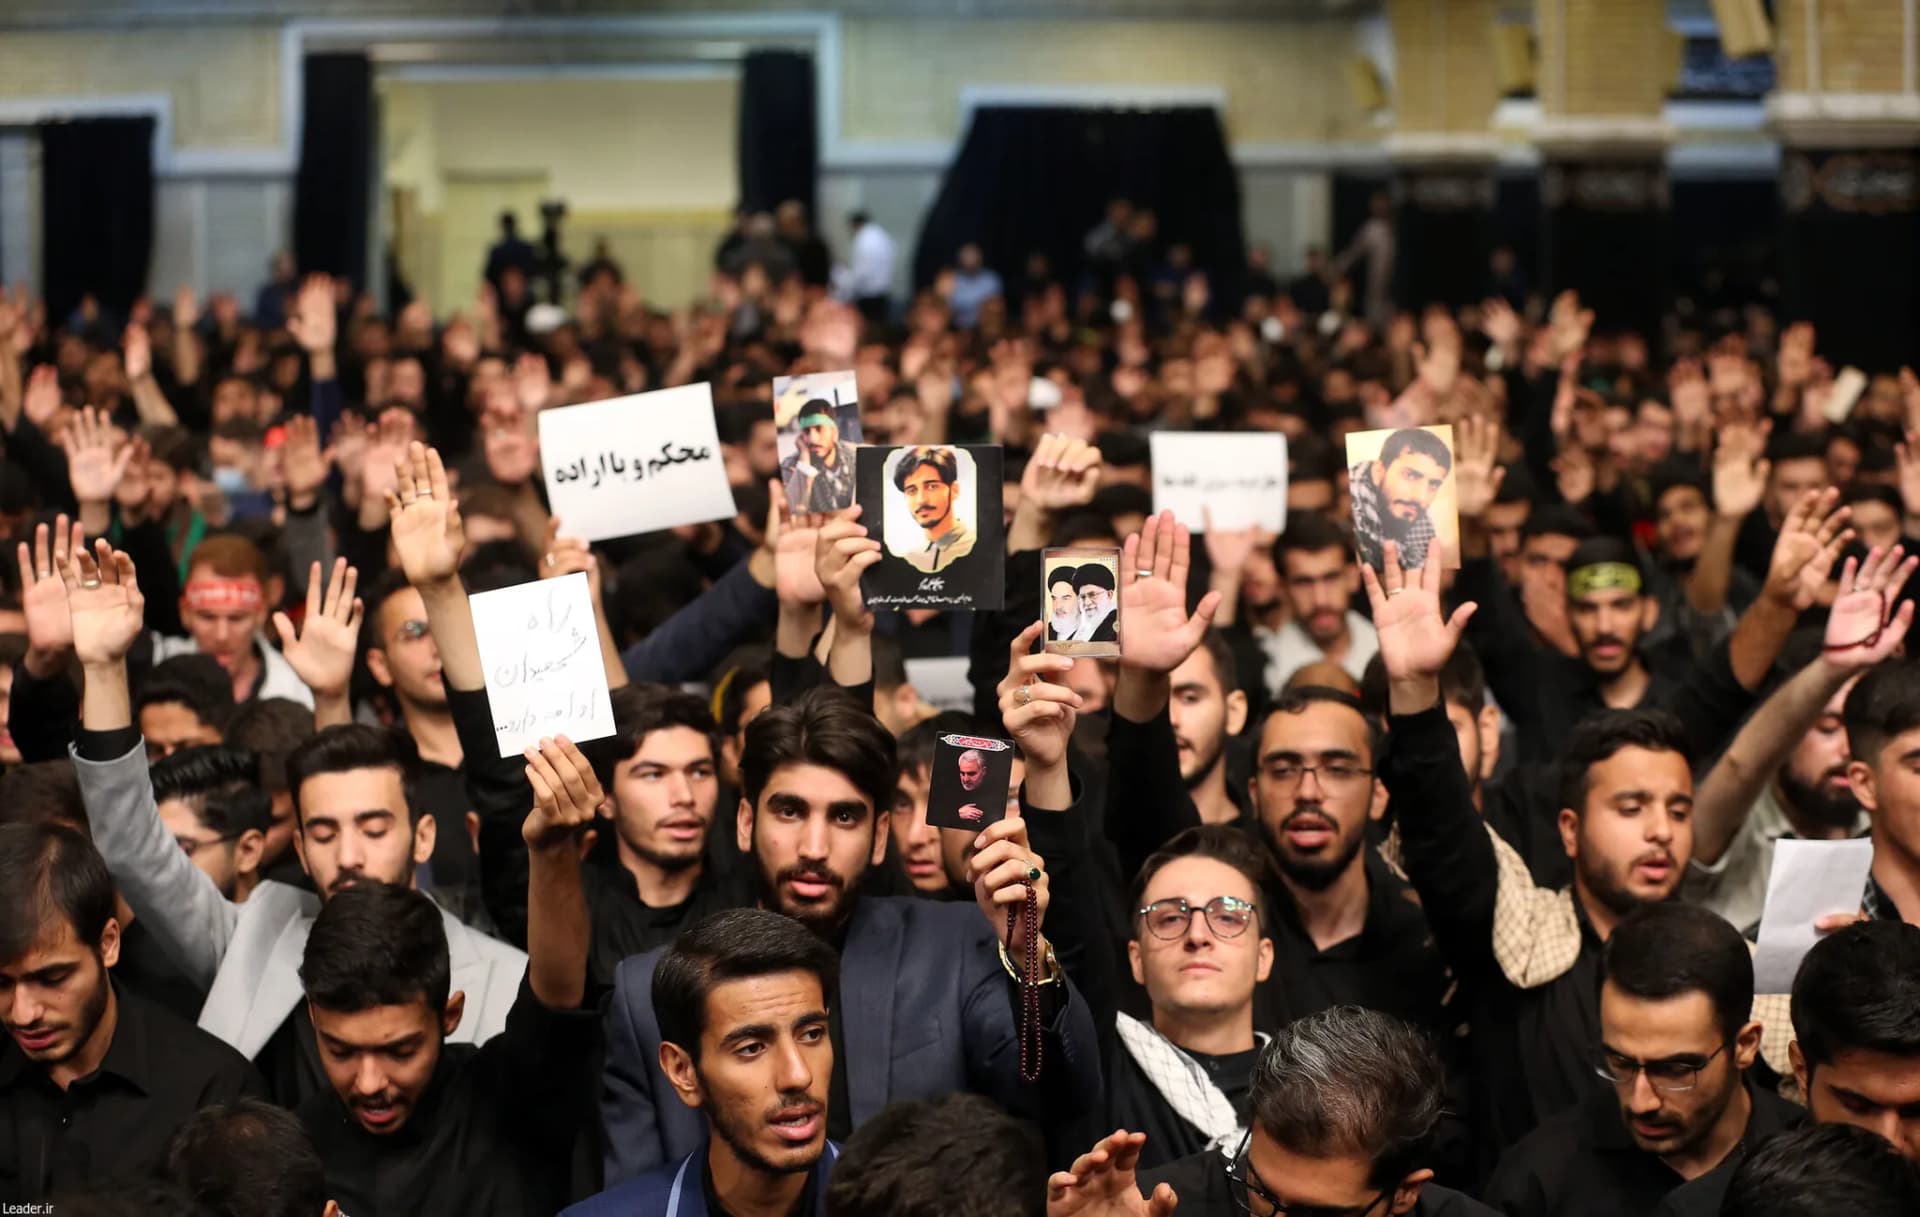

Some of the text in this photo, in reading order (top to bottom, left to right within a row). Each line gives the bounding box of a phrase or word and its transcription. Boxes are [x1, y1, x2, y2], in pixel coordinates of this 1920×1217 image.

[555, 441, 711, 488] محکم و با اراده
[527, 586, 572, 633] راه
[544, 688, 596, 720] ادامه
